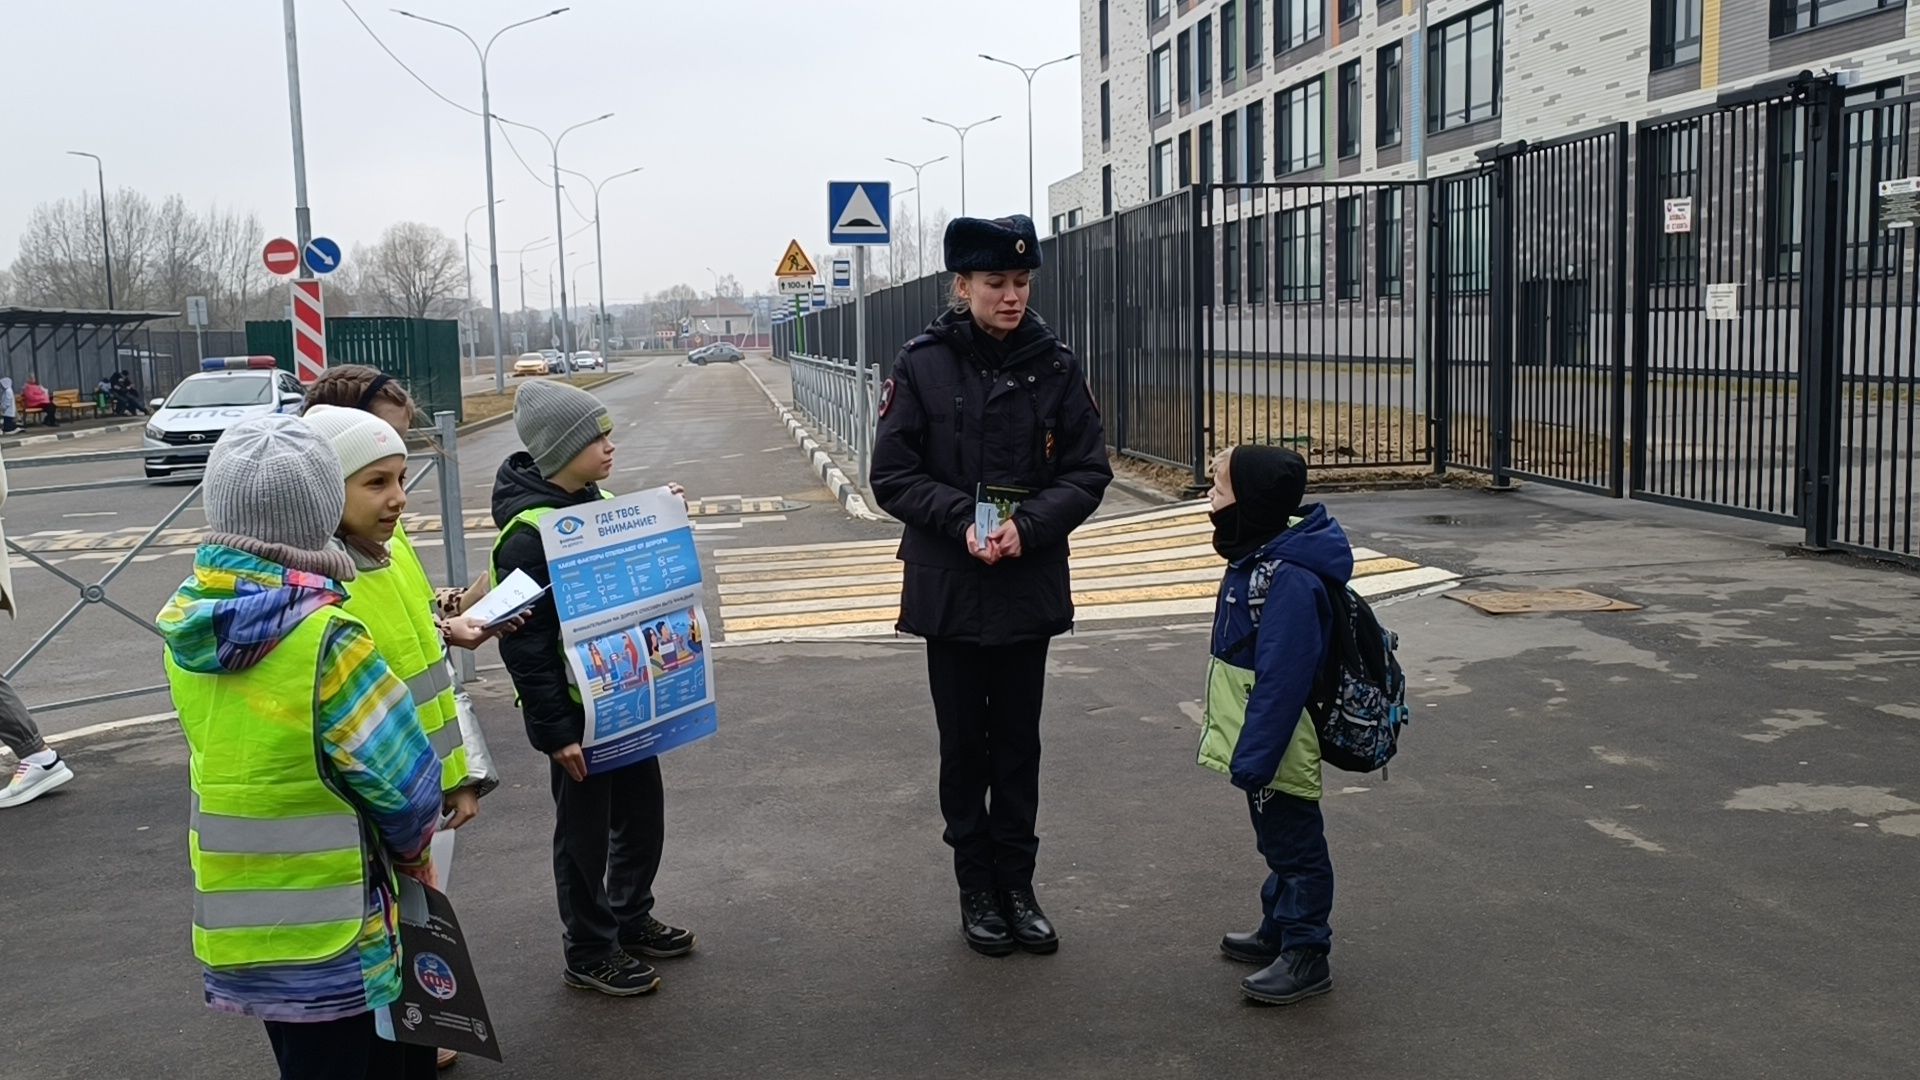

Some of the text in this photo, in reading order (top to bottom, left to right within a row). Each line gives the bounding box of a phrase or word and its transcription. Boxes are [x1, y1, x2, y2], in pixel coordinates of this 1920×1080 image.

[169, 408, 245, 422] ДПС
[595, 505, 641, 525] ГДЕ ТВОЕ
[598, 514, 657, 537] ВНИМАНИЕ?
